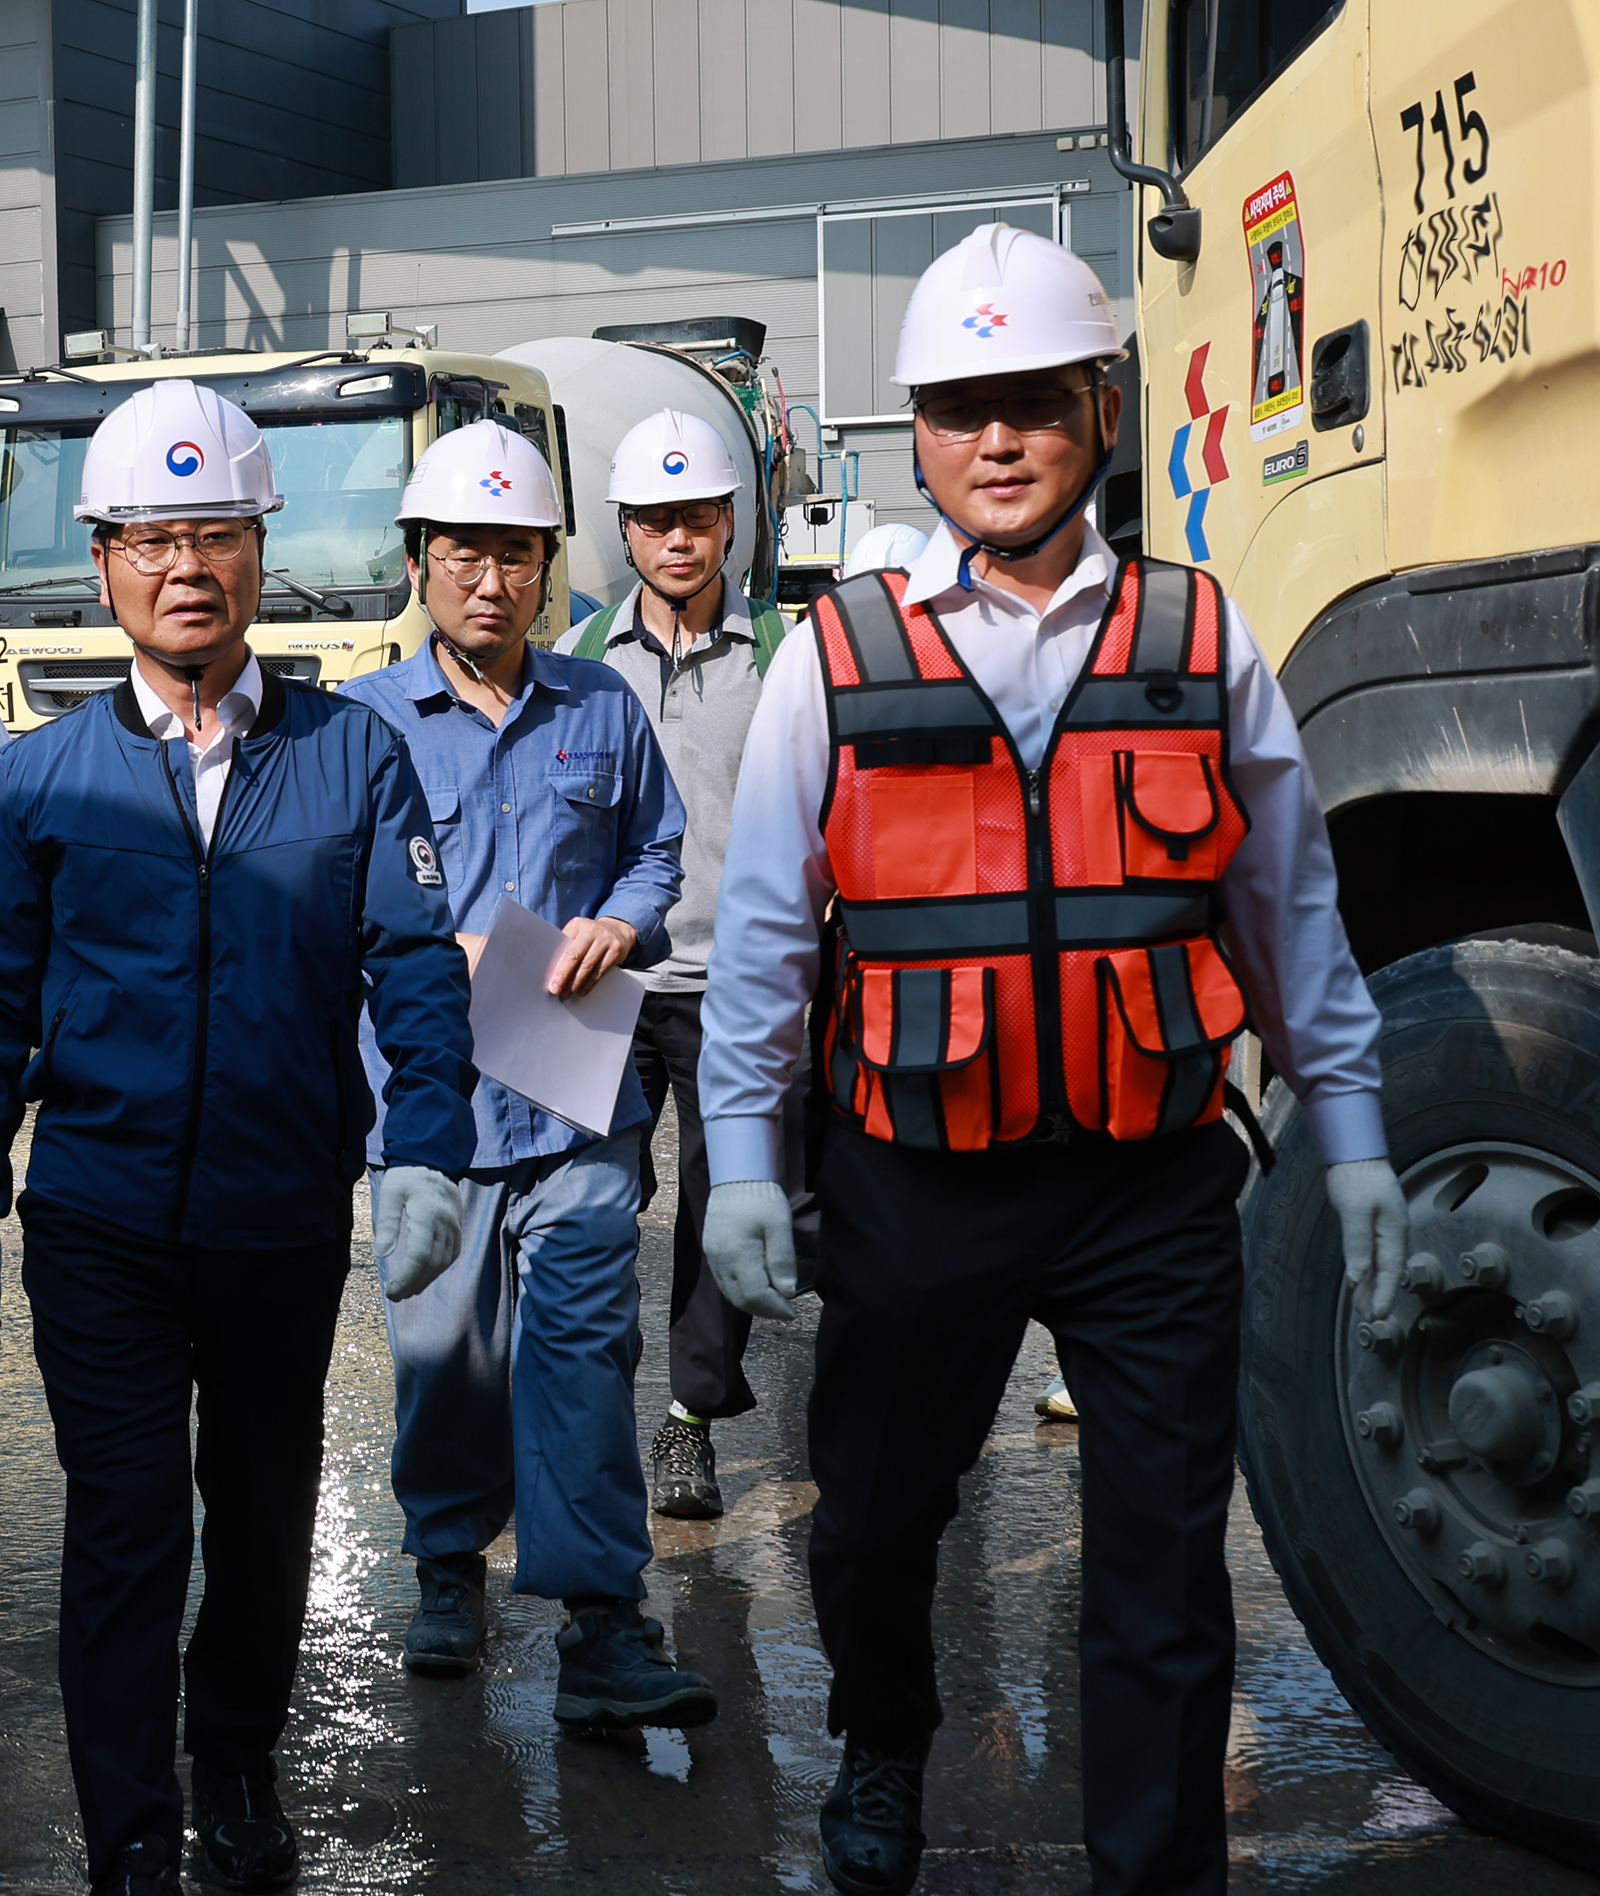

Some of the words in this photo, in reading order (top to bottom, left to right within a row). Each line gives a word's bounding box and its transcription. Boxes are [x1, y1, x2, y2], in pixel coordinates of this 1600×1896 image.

[1400, 70, 1490, 216] 715
[1250, 188, 1274, 219] 사각지대
[1272, 179, 1287, 204] 주의
[1264, 456, 1295, 476] EURO
[1296, 444, 1307, 467] 6
[287, 640, 341, 651] NOVUS
